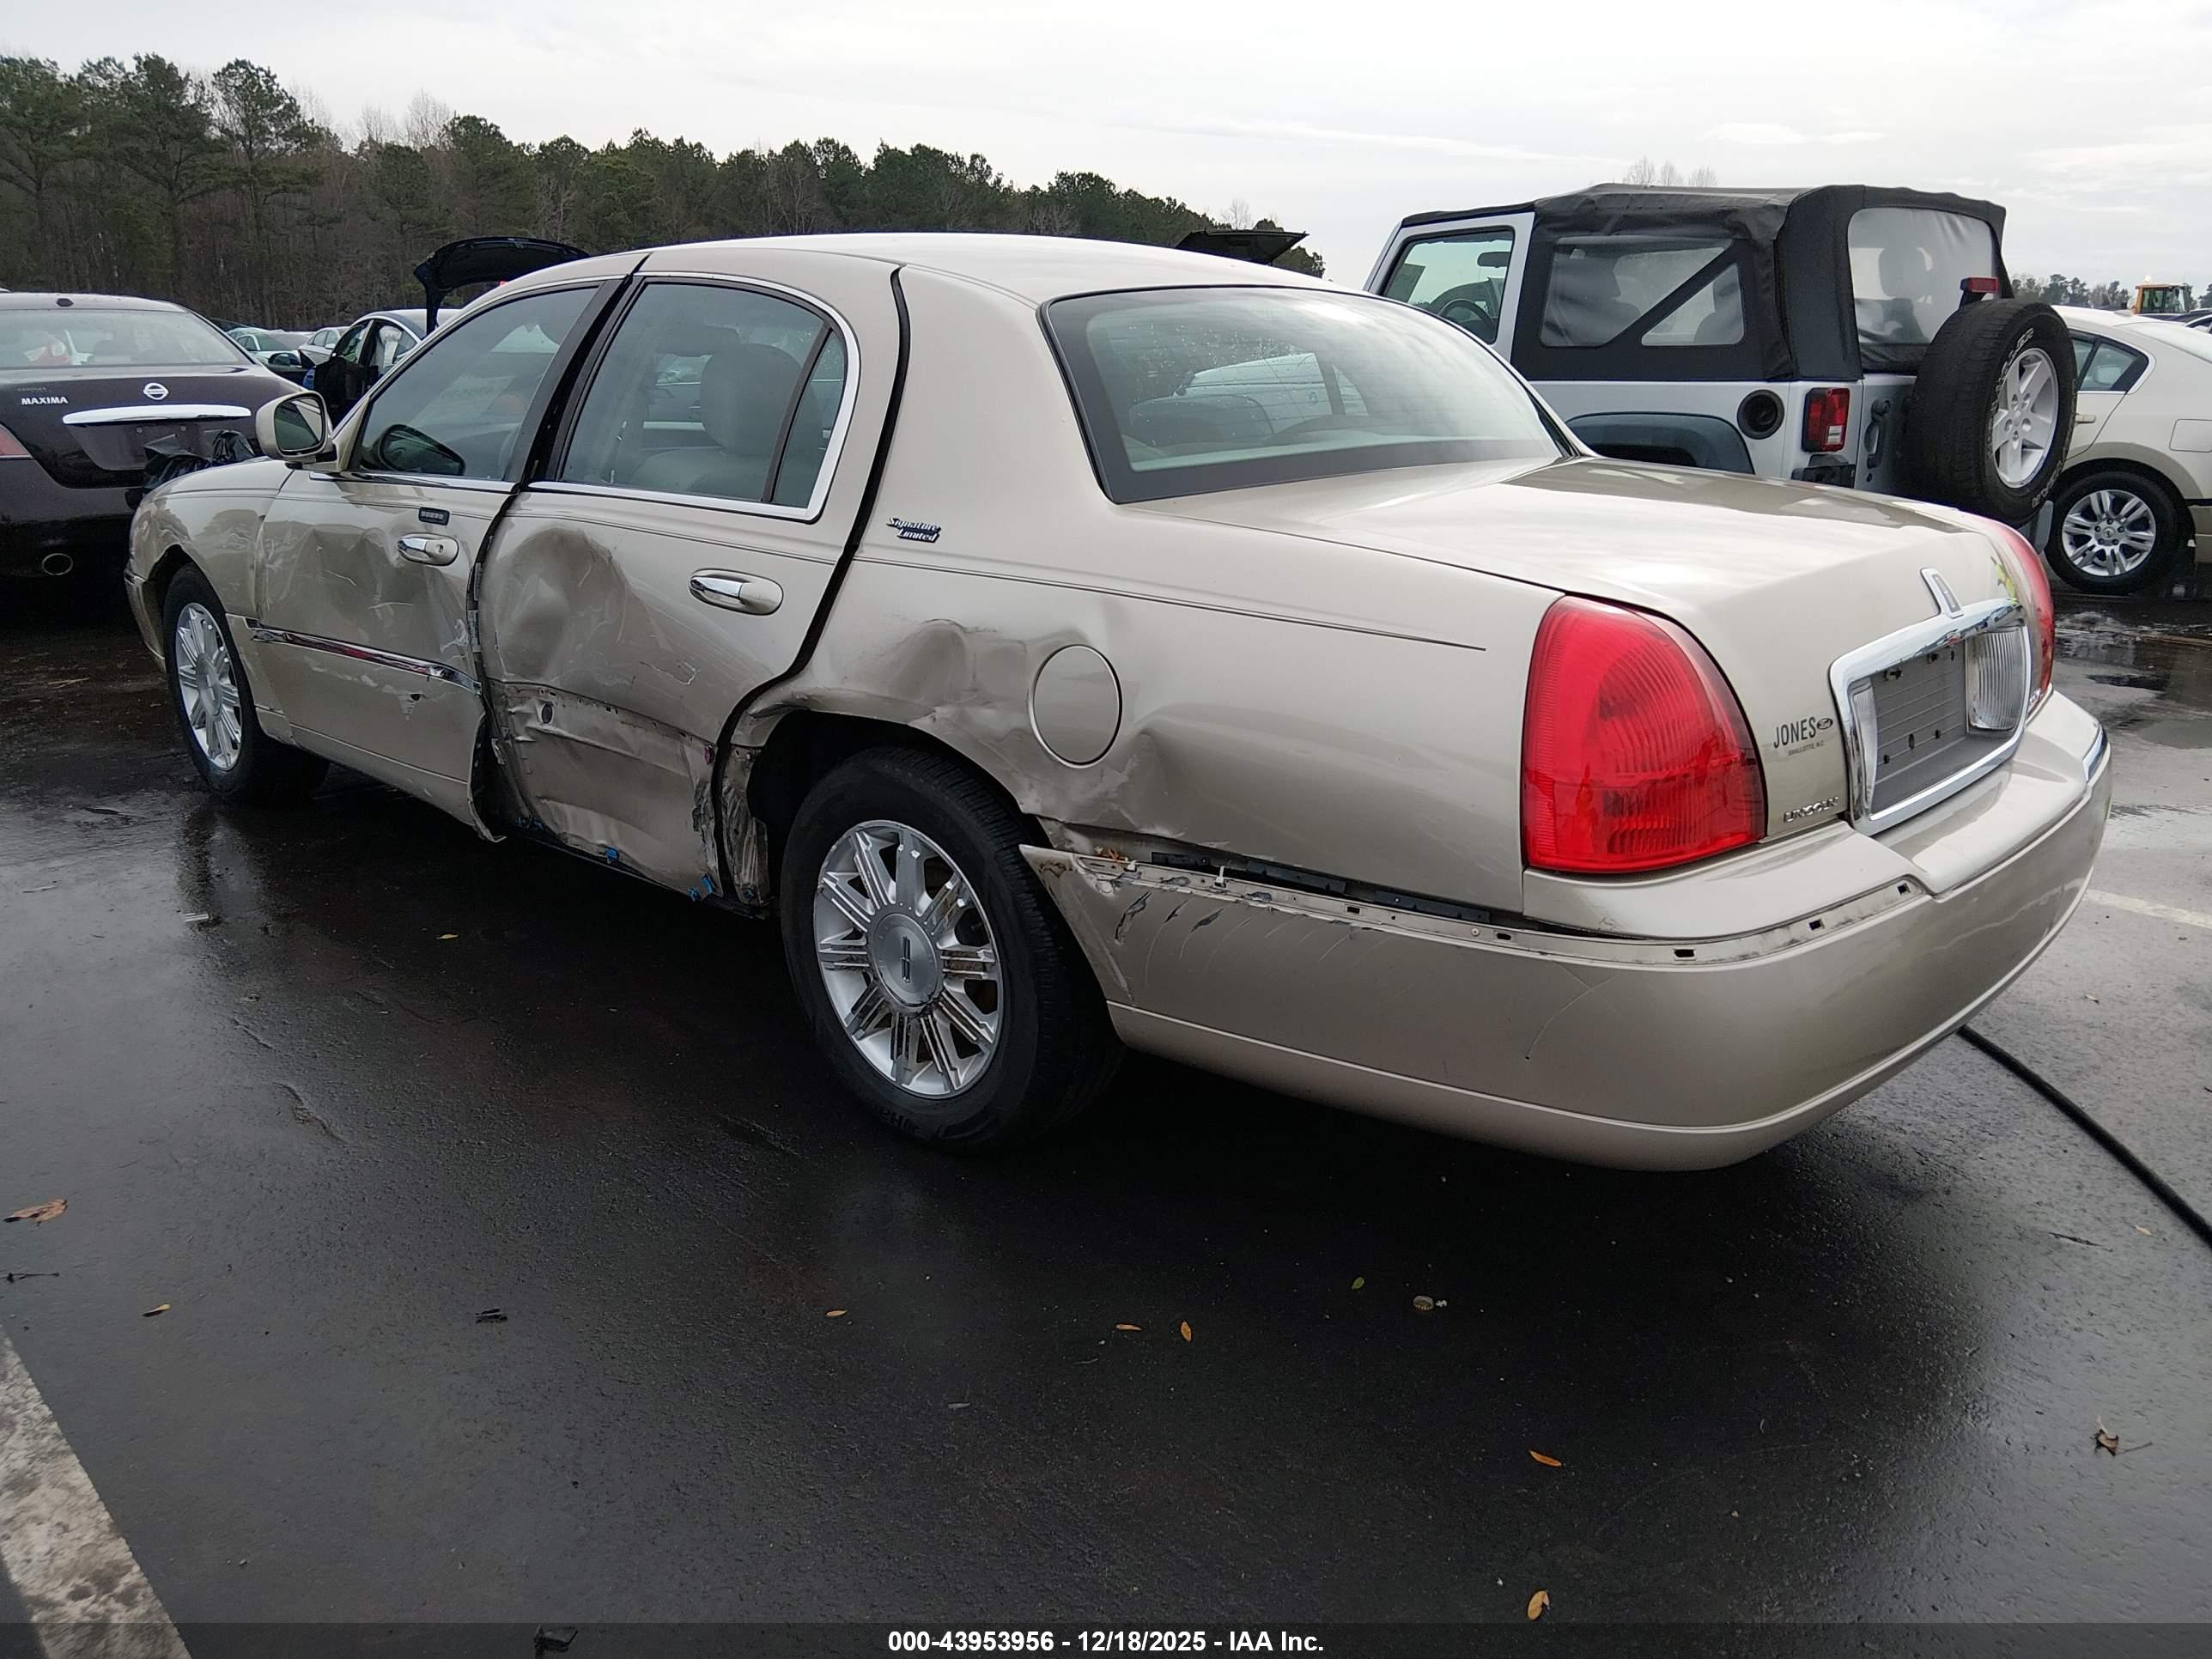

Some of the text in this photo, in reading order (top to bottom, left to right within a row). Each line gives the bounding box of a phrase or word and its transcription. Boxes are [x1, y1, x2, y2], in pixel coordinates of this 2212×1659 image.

[21, 396, 69, 405] MAXIMA
[888, 517, 940, 532] Signature
[897, 528, 939, 542] Limited
[1773, 716, 1817, 749] JONES
[1783, 795, 1840, 823] LINCOLN
